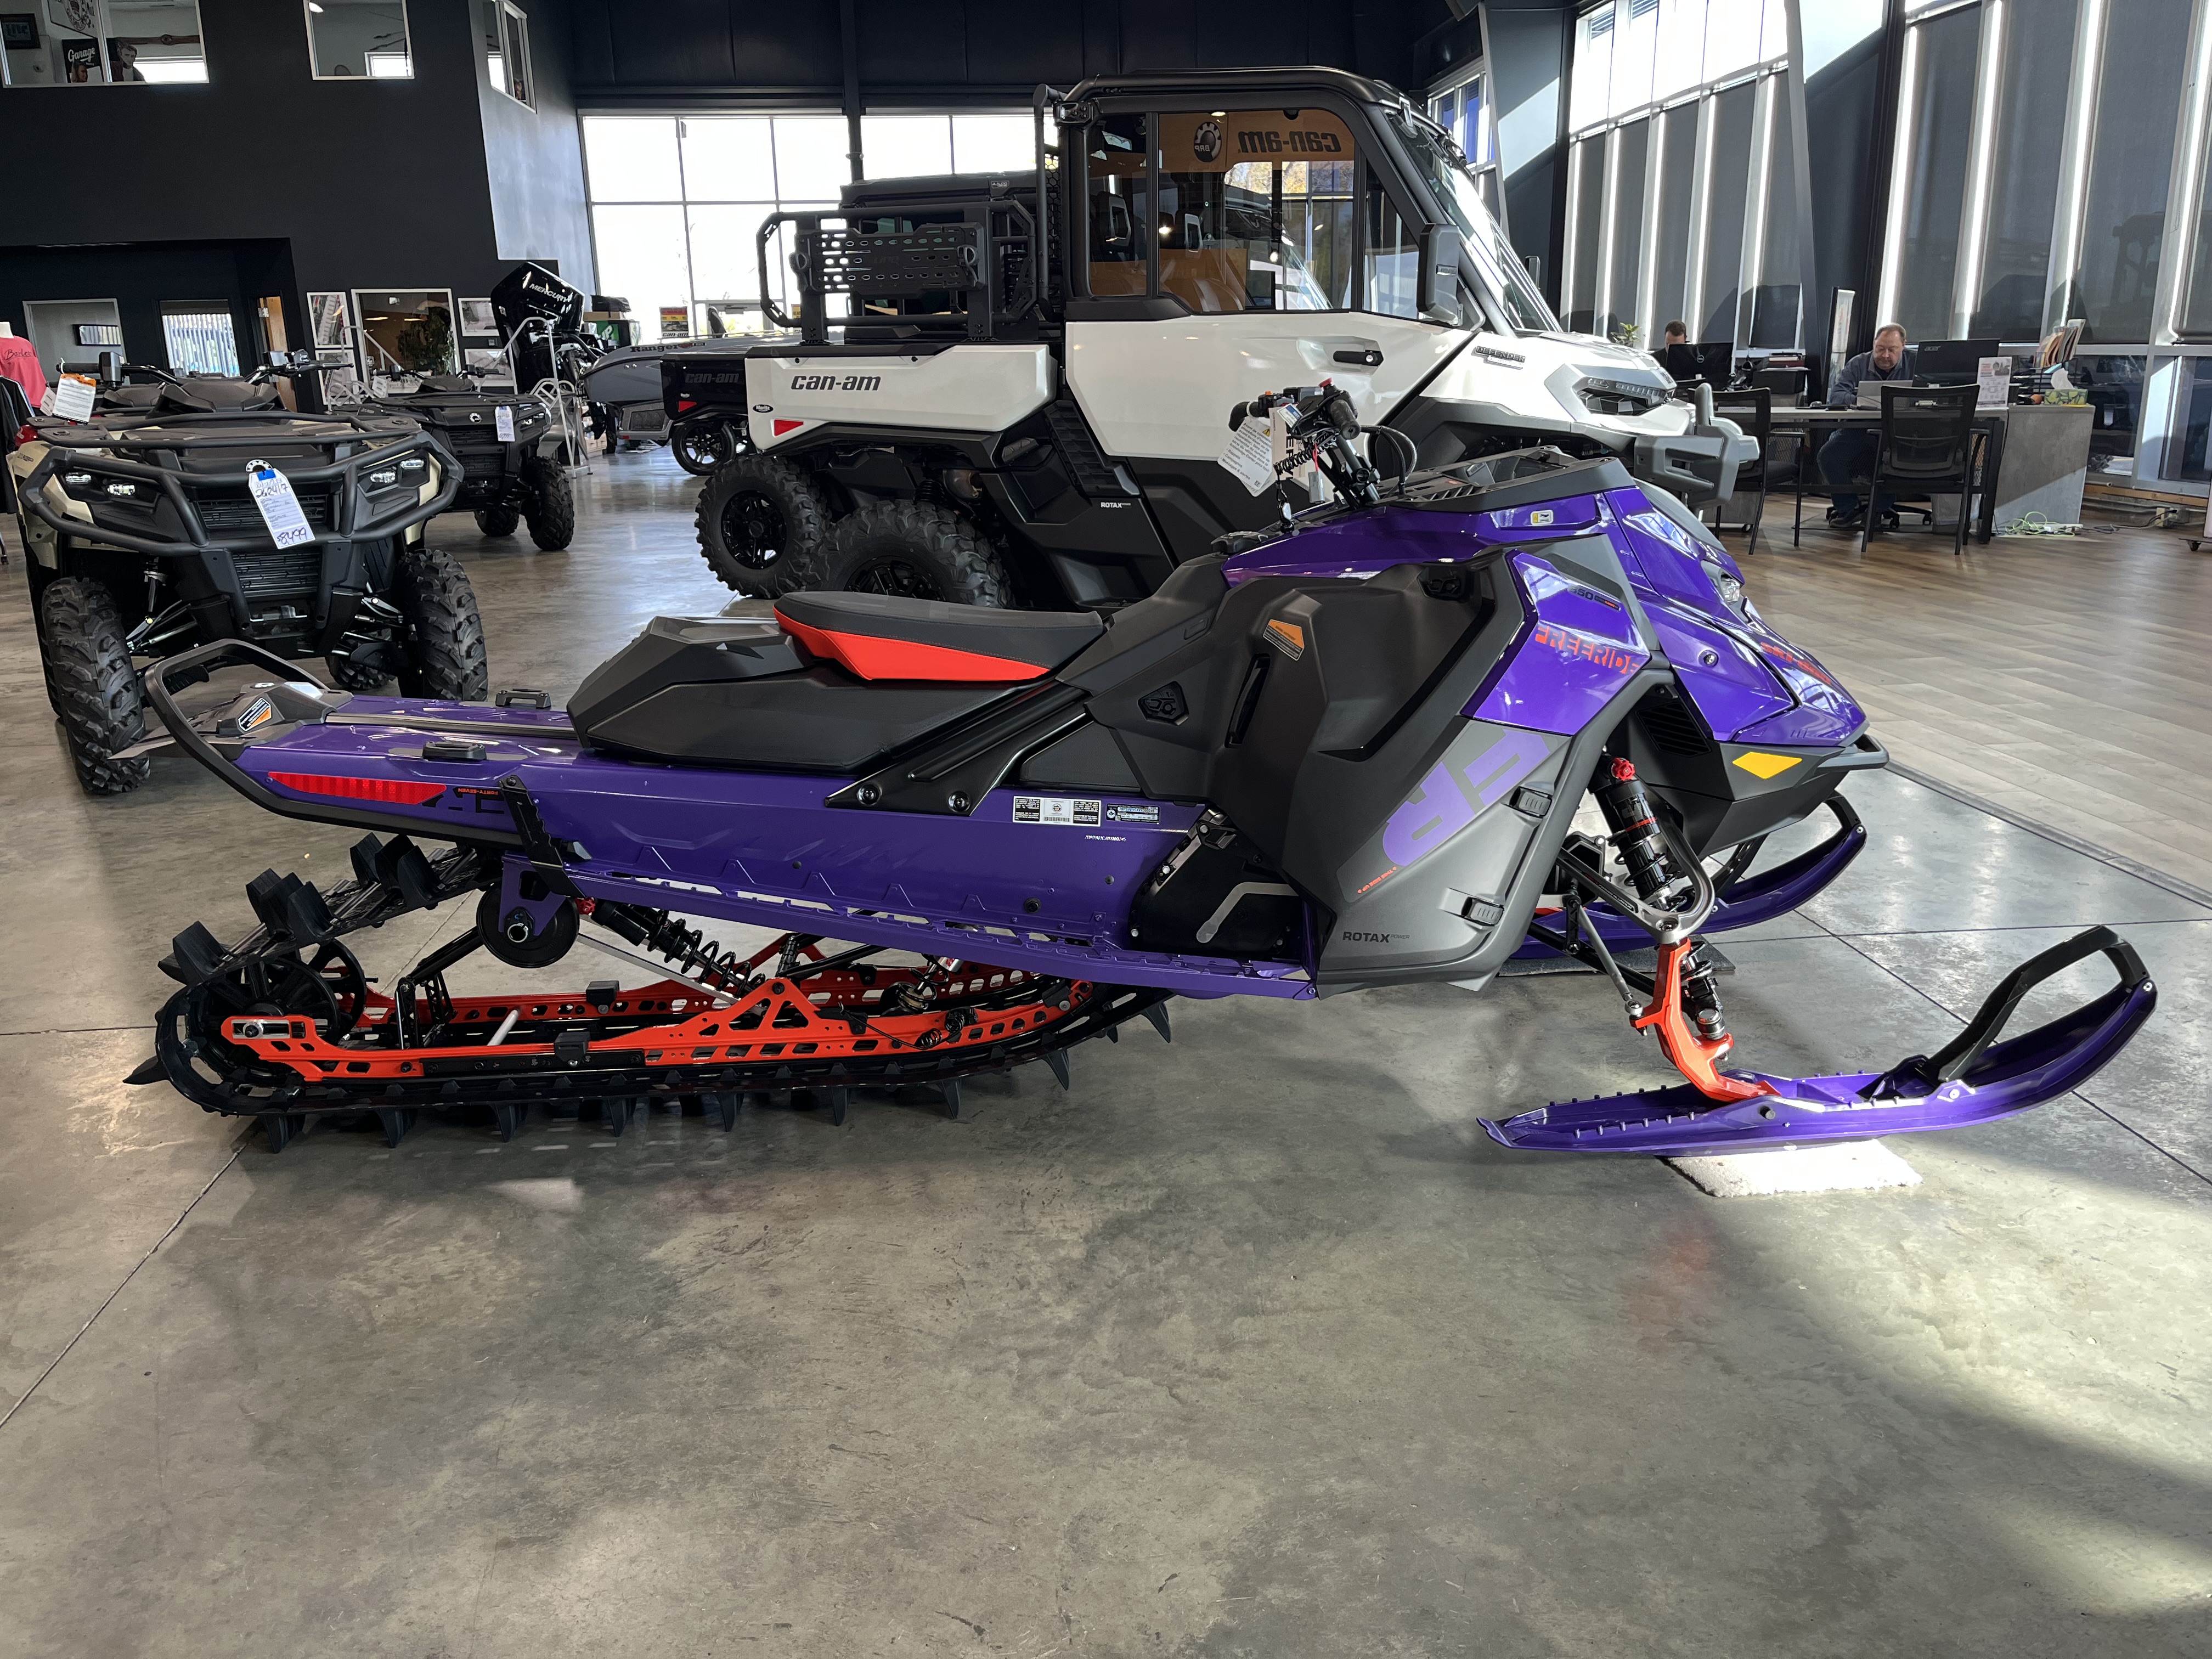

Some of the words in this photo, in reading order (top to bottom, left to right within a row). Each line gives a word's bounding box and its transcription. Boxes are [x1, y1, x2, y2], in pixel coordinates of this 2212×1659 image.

[68, 47, 95, 62] Garage
[529, 283, 570, 303] MERCURY
[630, 343, 678, 353] Ranger
[1476, 346, 1525, 363] DEFENDER
[685, 373, 740, 383] can-am
[791, 375, 881, 391] can-am
[458, 787, 499, 795] FORTY-SEVEN
[1342, 932, 1390, 943] ROTAX
